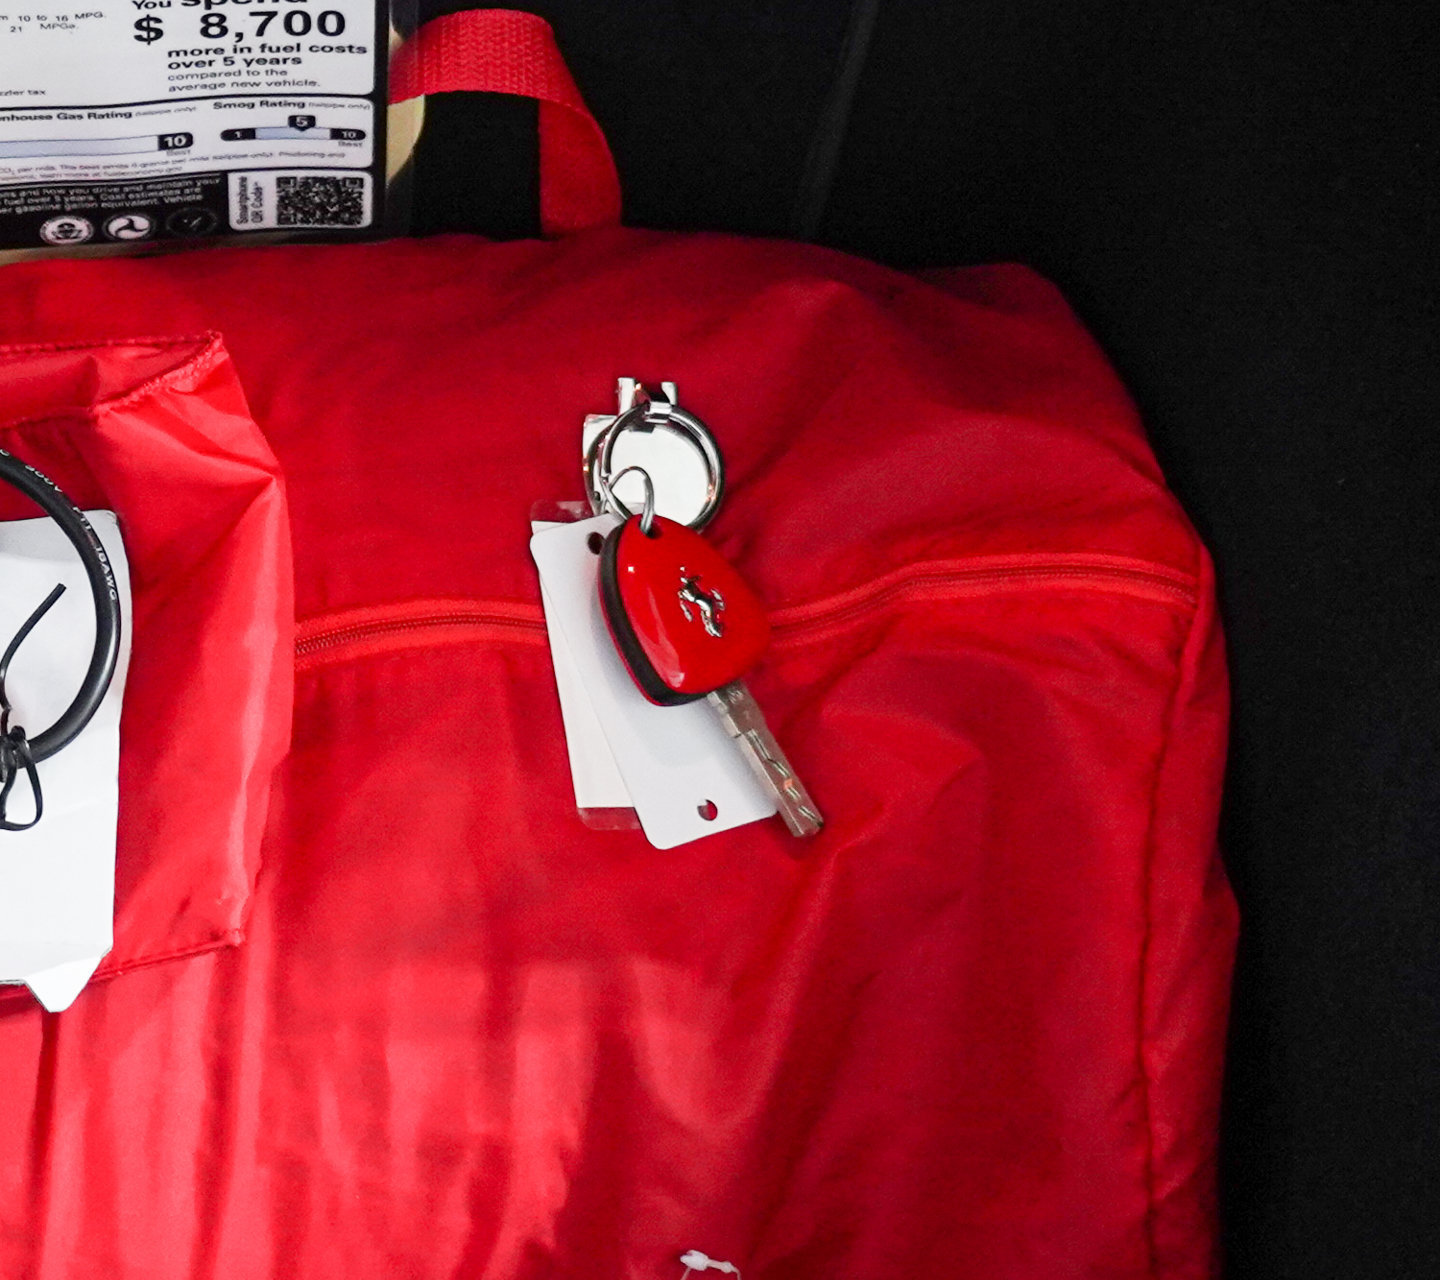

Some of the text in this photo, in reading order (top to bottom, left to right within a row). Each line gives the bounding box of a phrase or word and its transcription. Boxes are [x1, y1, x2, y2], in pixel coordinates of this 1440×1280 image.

[132, 0, 172, 10] You
[133, 10, 347, 45] $ 8,700
[167, 43, 368, 58] more in fuel costs
[167, 56, 303, 70] over 5 years
